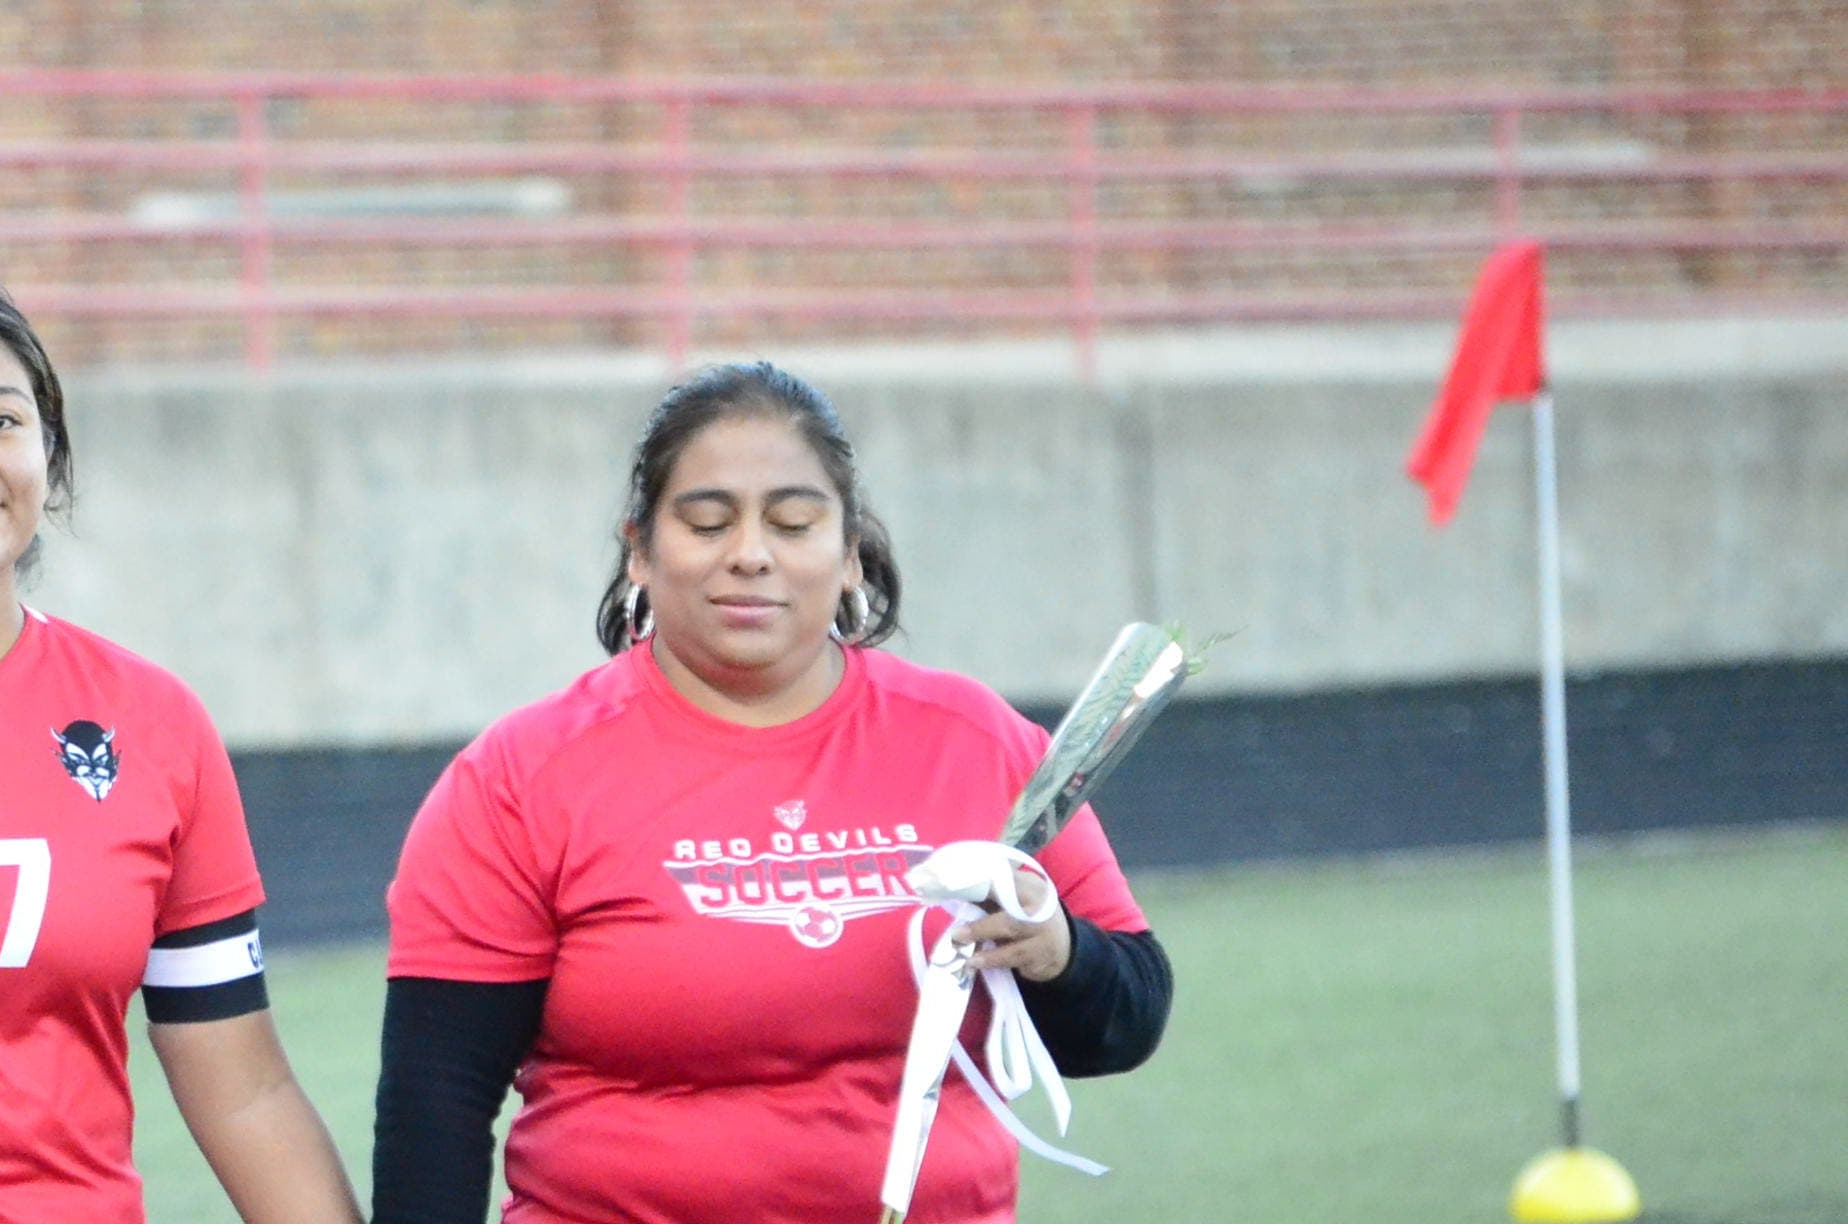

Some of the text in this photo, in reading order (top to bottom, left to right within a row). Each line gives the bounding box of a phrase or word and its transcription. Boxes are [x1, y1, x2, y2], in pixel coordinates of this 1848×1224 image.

[673, 823, 919, 860] RED DEVILS
[695, 851, 919, 908] SOCCER
